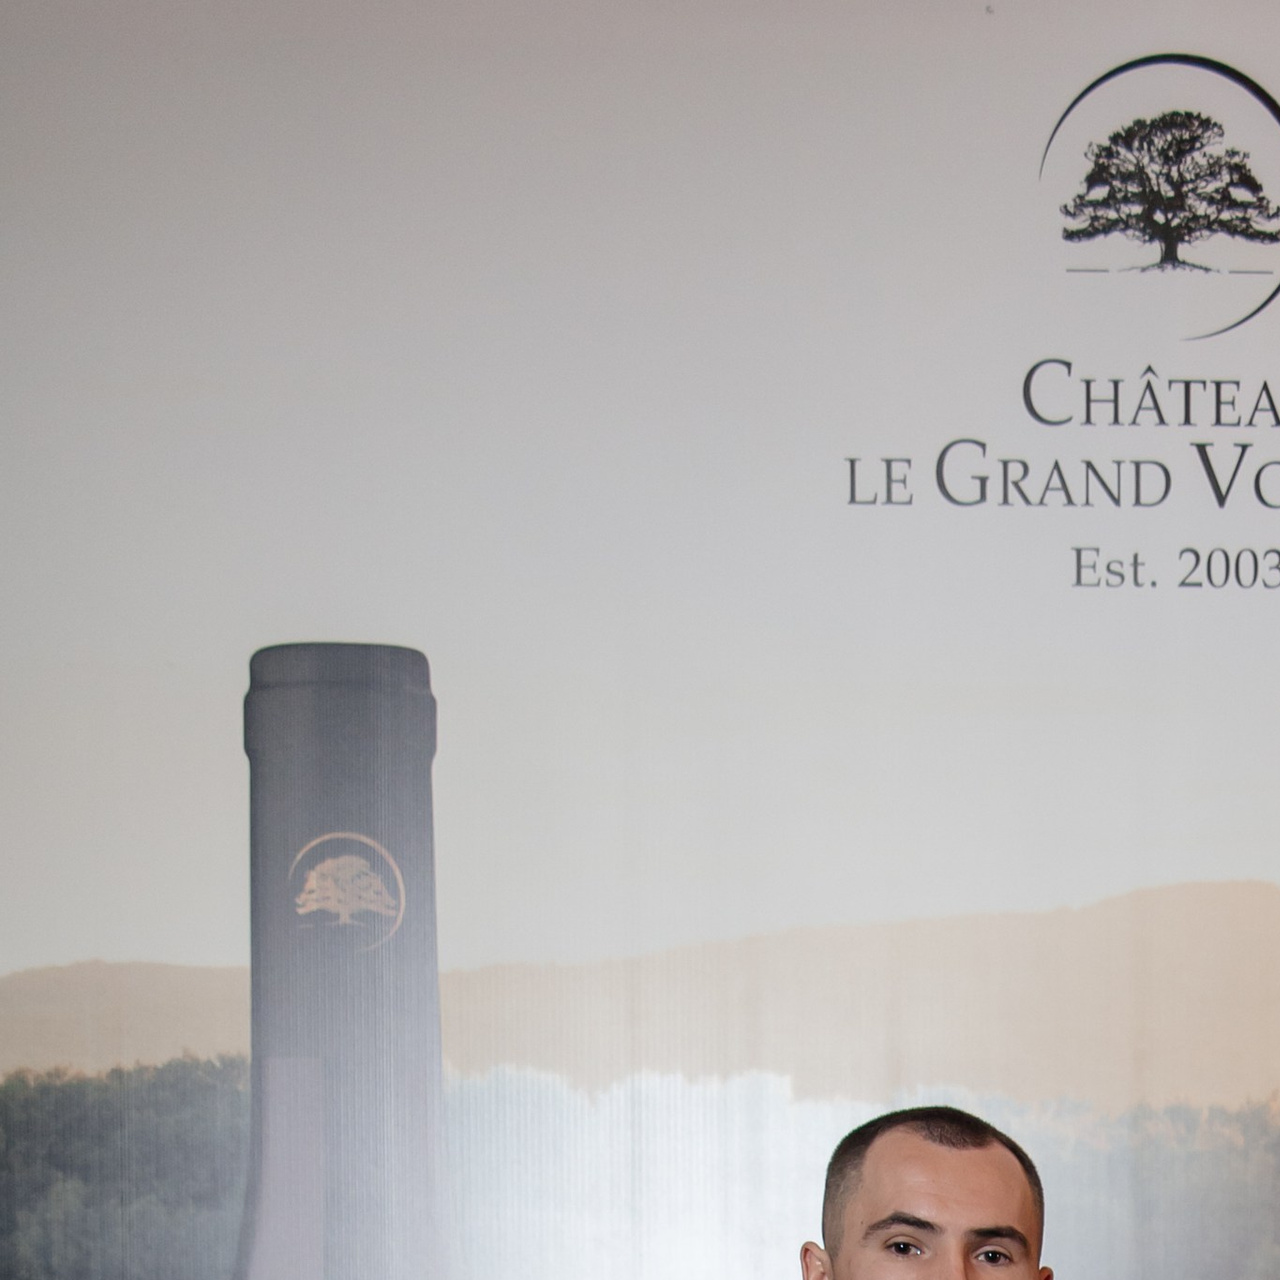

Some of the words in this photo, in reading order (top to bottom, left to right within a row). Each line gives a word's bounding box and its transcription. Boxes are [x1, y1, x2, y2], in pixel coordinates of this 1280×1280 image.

[845, 457, 914, 507] LE
[934, 438, 1173, 508] GRAND
[1070, 546, 1158, 589] Est.
